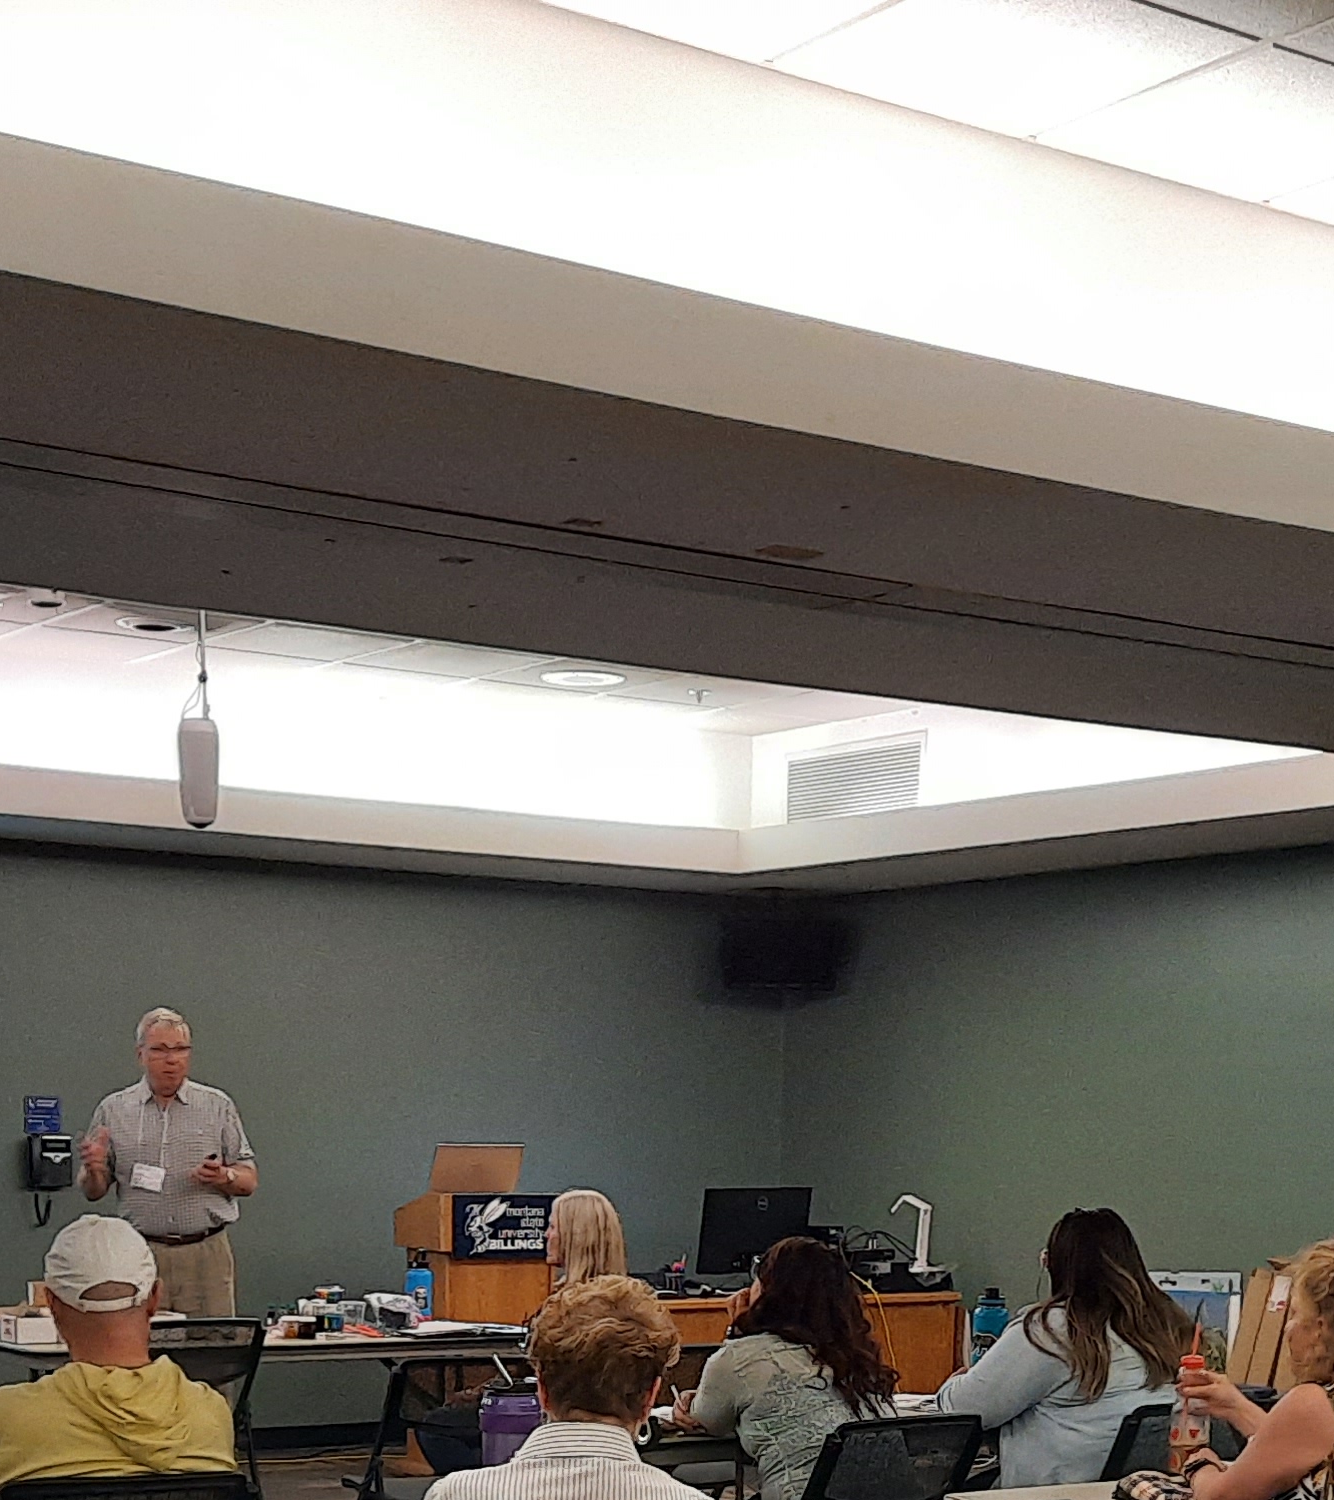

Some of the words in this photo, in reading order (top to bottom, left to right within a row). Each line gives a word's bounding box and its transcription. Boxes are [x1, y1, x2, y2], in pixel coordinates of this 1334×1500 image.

[507, 1205, 545, 1217] montana
[521, 1217, 545, 1229] state
[498, 1228, 548, 1241] university
[488, 1239, 545, 1250] BILLINGS
